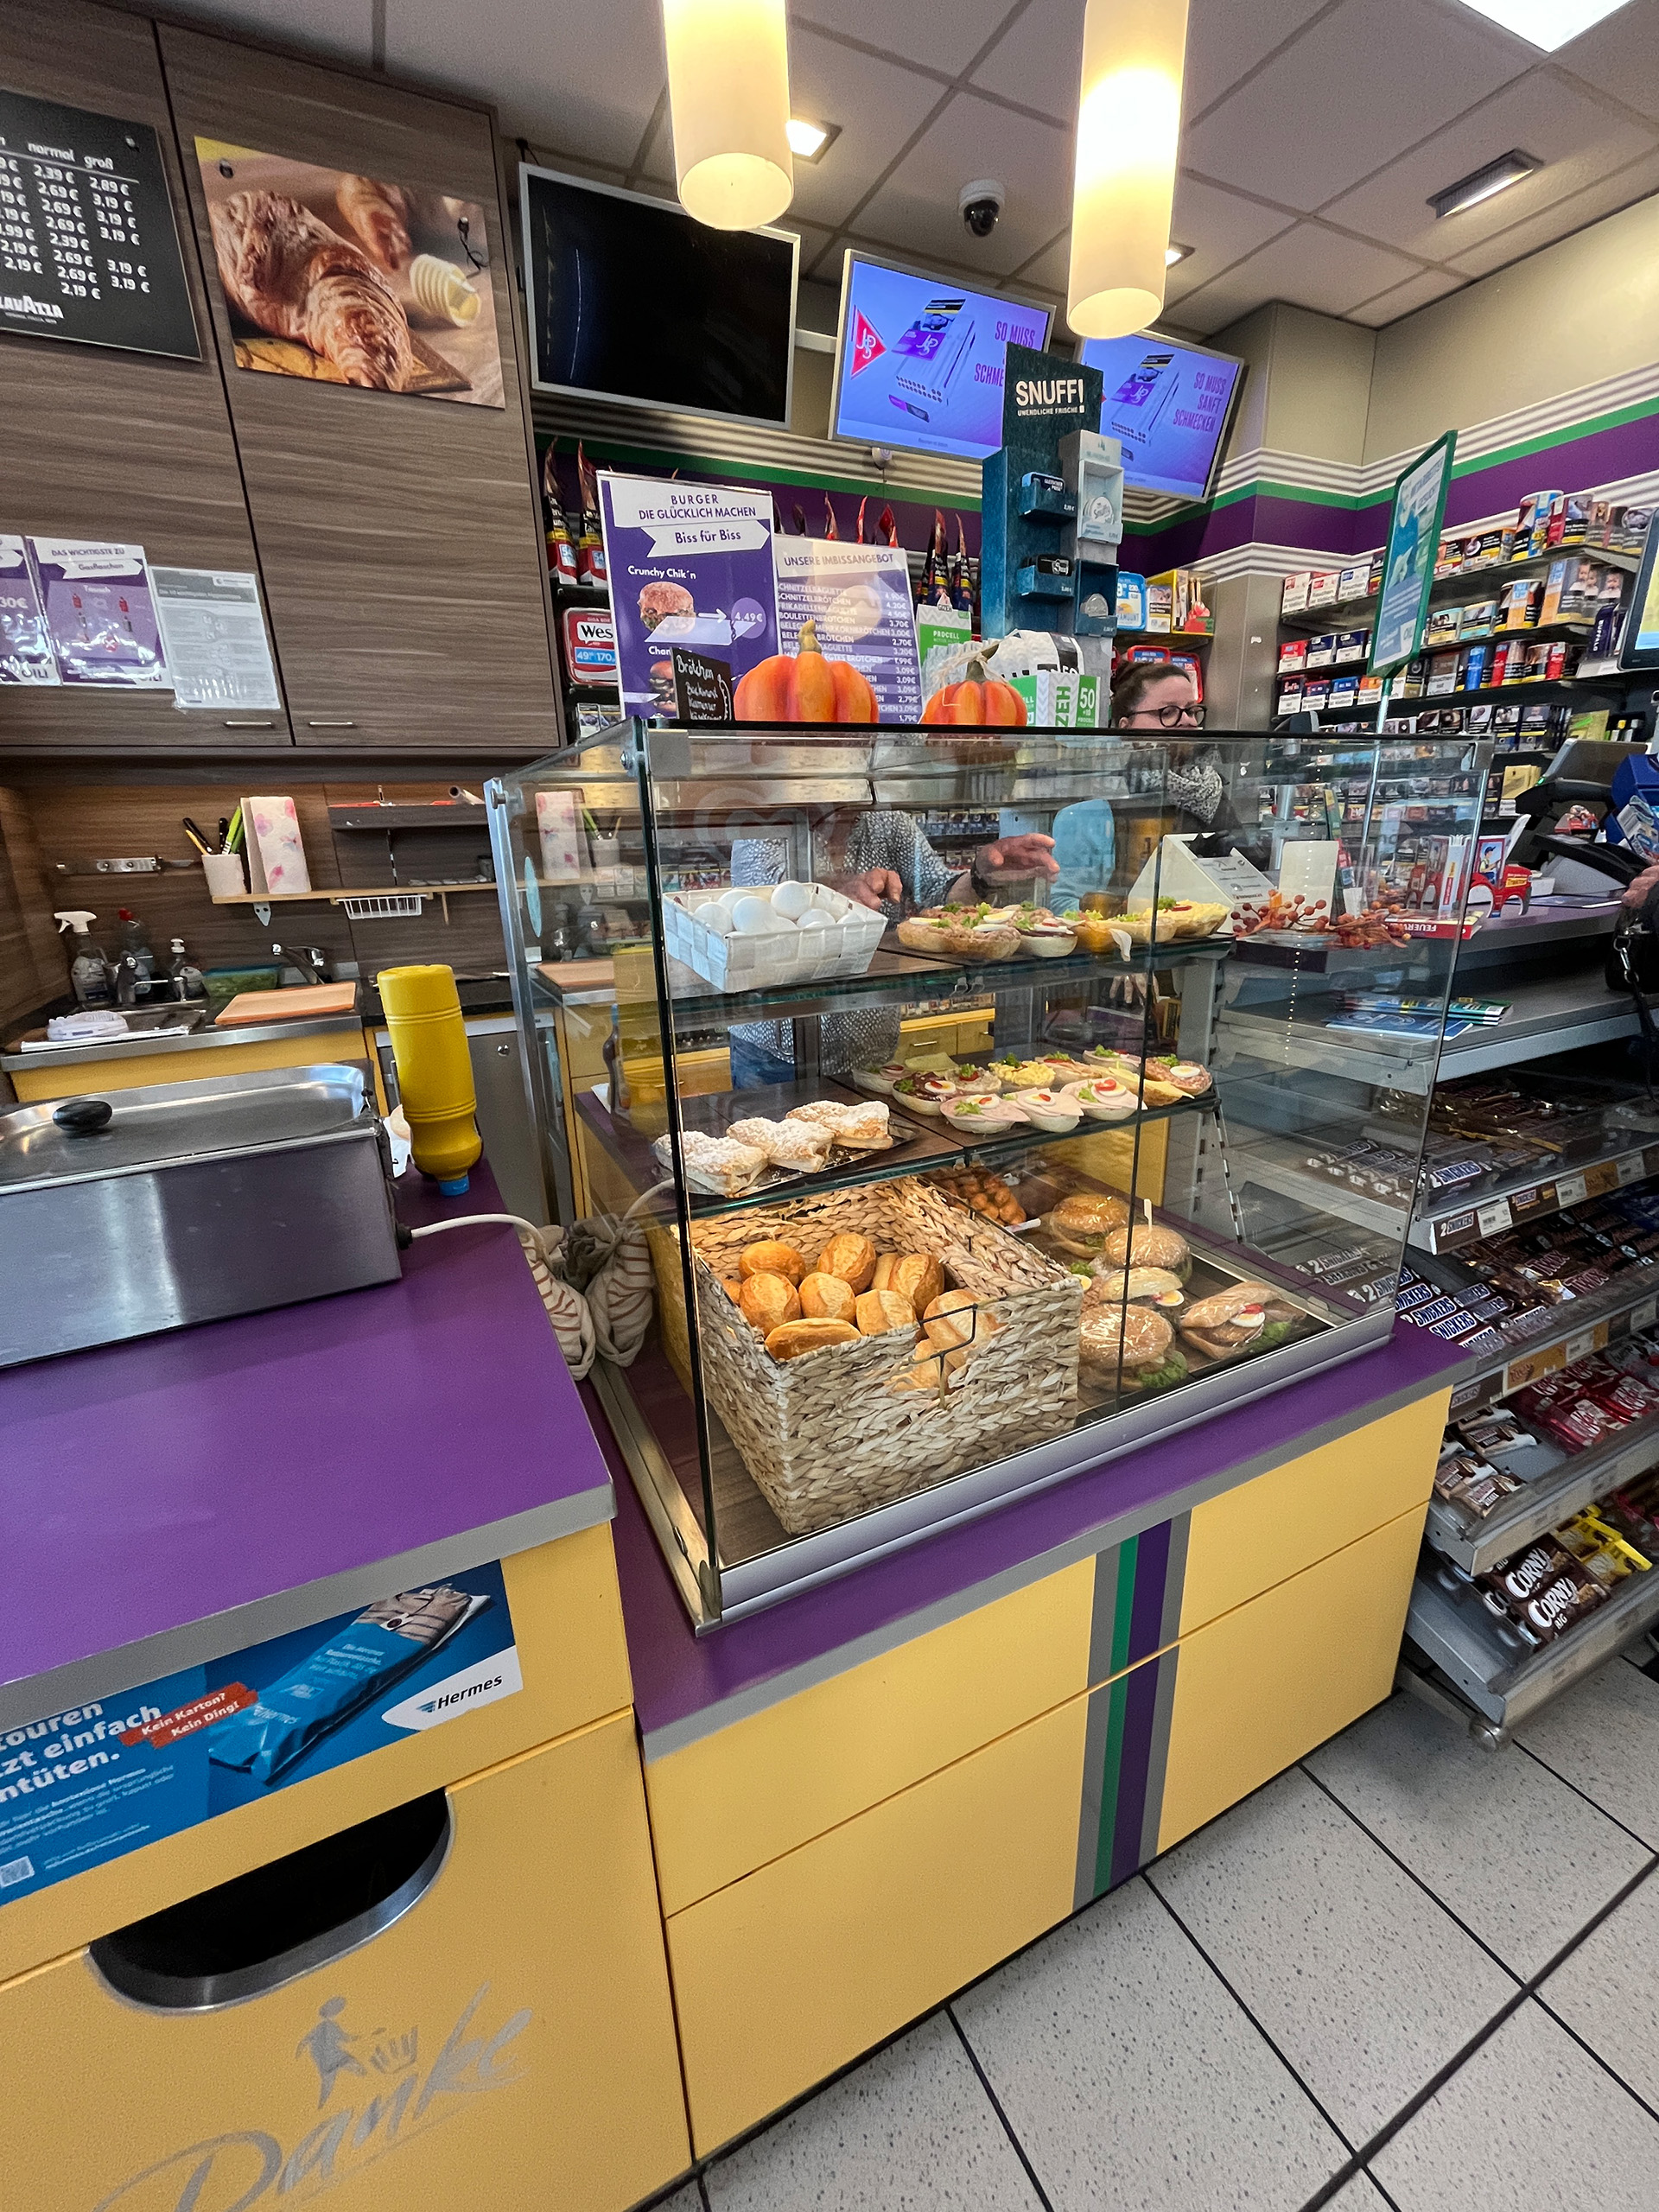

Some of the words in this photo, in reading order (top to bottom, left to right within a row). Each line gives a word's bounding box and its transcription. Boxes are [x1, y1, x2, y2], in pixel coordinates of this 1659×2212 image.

[28, 142, 75, 162] normal
[84, 156, 113, 170] groß
[995, 321, 1007, 341] SO
[1010, 326, 1036, 346] MUSS
[974, 363, 1004, 387] SCHME
[1194, 372, 1205, 390] SO
[1205, 375, 1227, 395] MUSS
[1016, 379, 1084, 413] SNUFF!
[1198, 394, 1223, 414] SANFT
[1173, 409, 1217, 433] SCHMECKEN
[671, 494, 719, 505] BURGER
[639, 510, 655, 520] DIE
[657, 506, 714, 519] GLÜCKLICH
[715, 507, 756, 518] MACHEN
[675, 531, 698, 543] Biss
[700, 530, 717, 543] für
[720, 529, 741, 541] Biss
[68, 548, 113, 556] WICHTIGSTE
[784, 556, 821, 566] UNSERE
[822, 554, 894, 566] IMBISSANGEBOT
[79, 563, 124, 571] Gasflaschen
[627, 565, 664, 579] Crunchy
[779, 583, 848, 597] CHNITZELBAGUETTE
[734, 612, 763, 622] 4.49€
[581, 624, 613, 639] Wes
[1055, 686, 1071, 727] ZEH
[1079, 687, 1095, 709] 50
[1400, 923, 1437, 932] FEUER
[1436, 1160, 1480, 1184] SNICKERS
[1440, 1223, 1447, 1236] 2
[1412, 1297, 1457, 1327] SNICKERS
[1429, 1311, 1477, 1339] SNICKERS
[1505, 1548, 1552, 1599] CORNY
[1528, 1577, 1578, 1628] CORNY
[1554, 1613, 1568, 1630] BIG
[438, 1675, 503, 1711] Hermes
[141, 1716, 174, 1736] Kein
[175, 1692, 226, 1720] Karton?
[170, 1721, 203, 1738] Kein
[204, 1700, 240, 1726] Ding!
[44, 1706, 162, 1759] einfach
[0, 1751, 120, 1802] ntüten.
